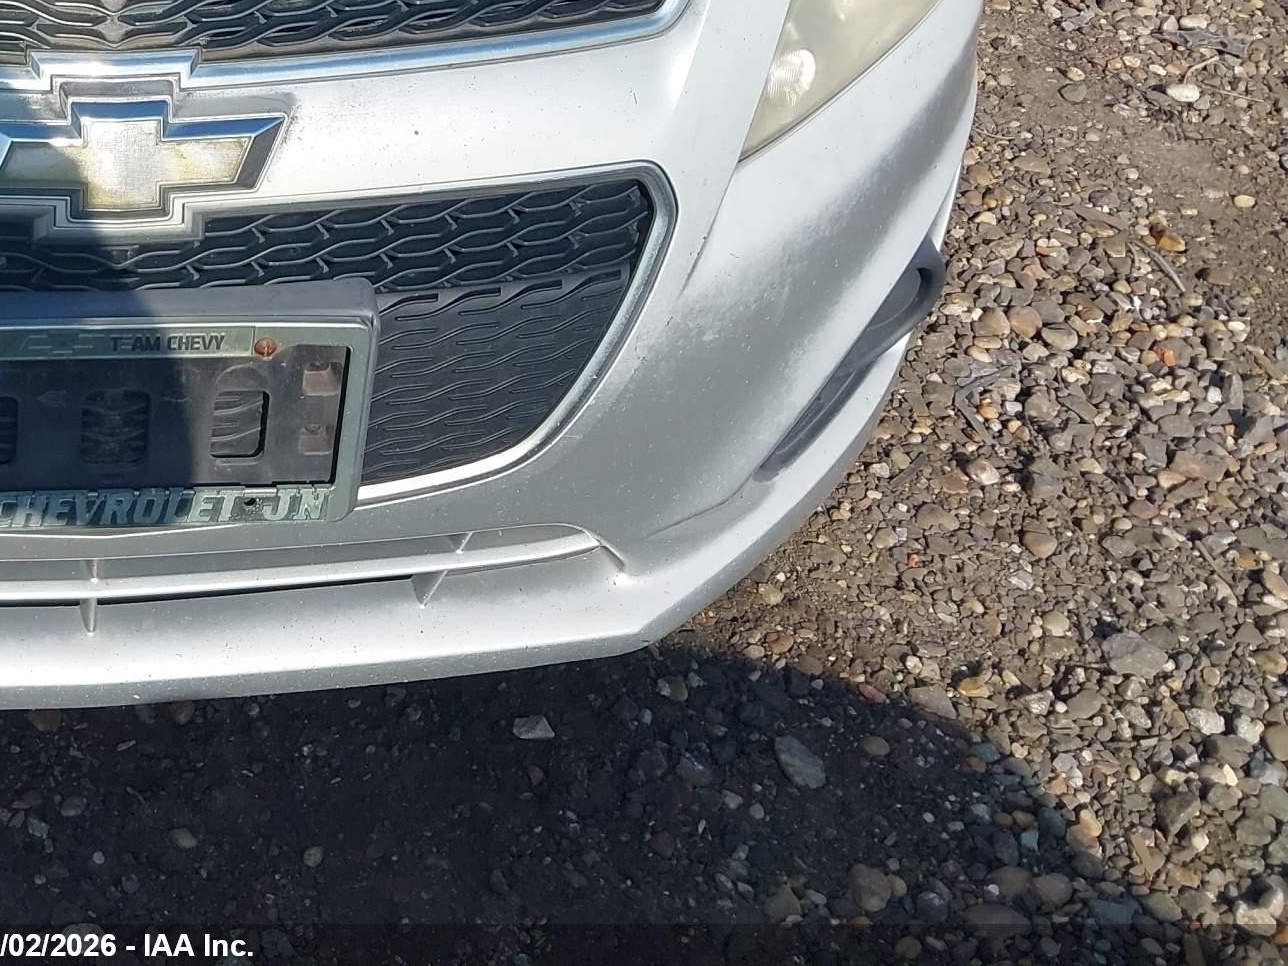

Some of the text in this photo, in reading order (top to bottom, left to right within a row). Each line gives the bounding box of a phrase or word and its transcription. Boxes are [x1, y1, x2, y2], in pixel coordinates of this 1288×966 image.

[110, 334, 226, 352] TEAM CHEVY
[262, 489, 330, 521] JN
